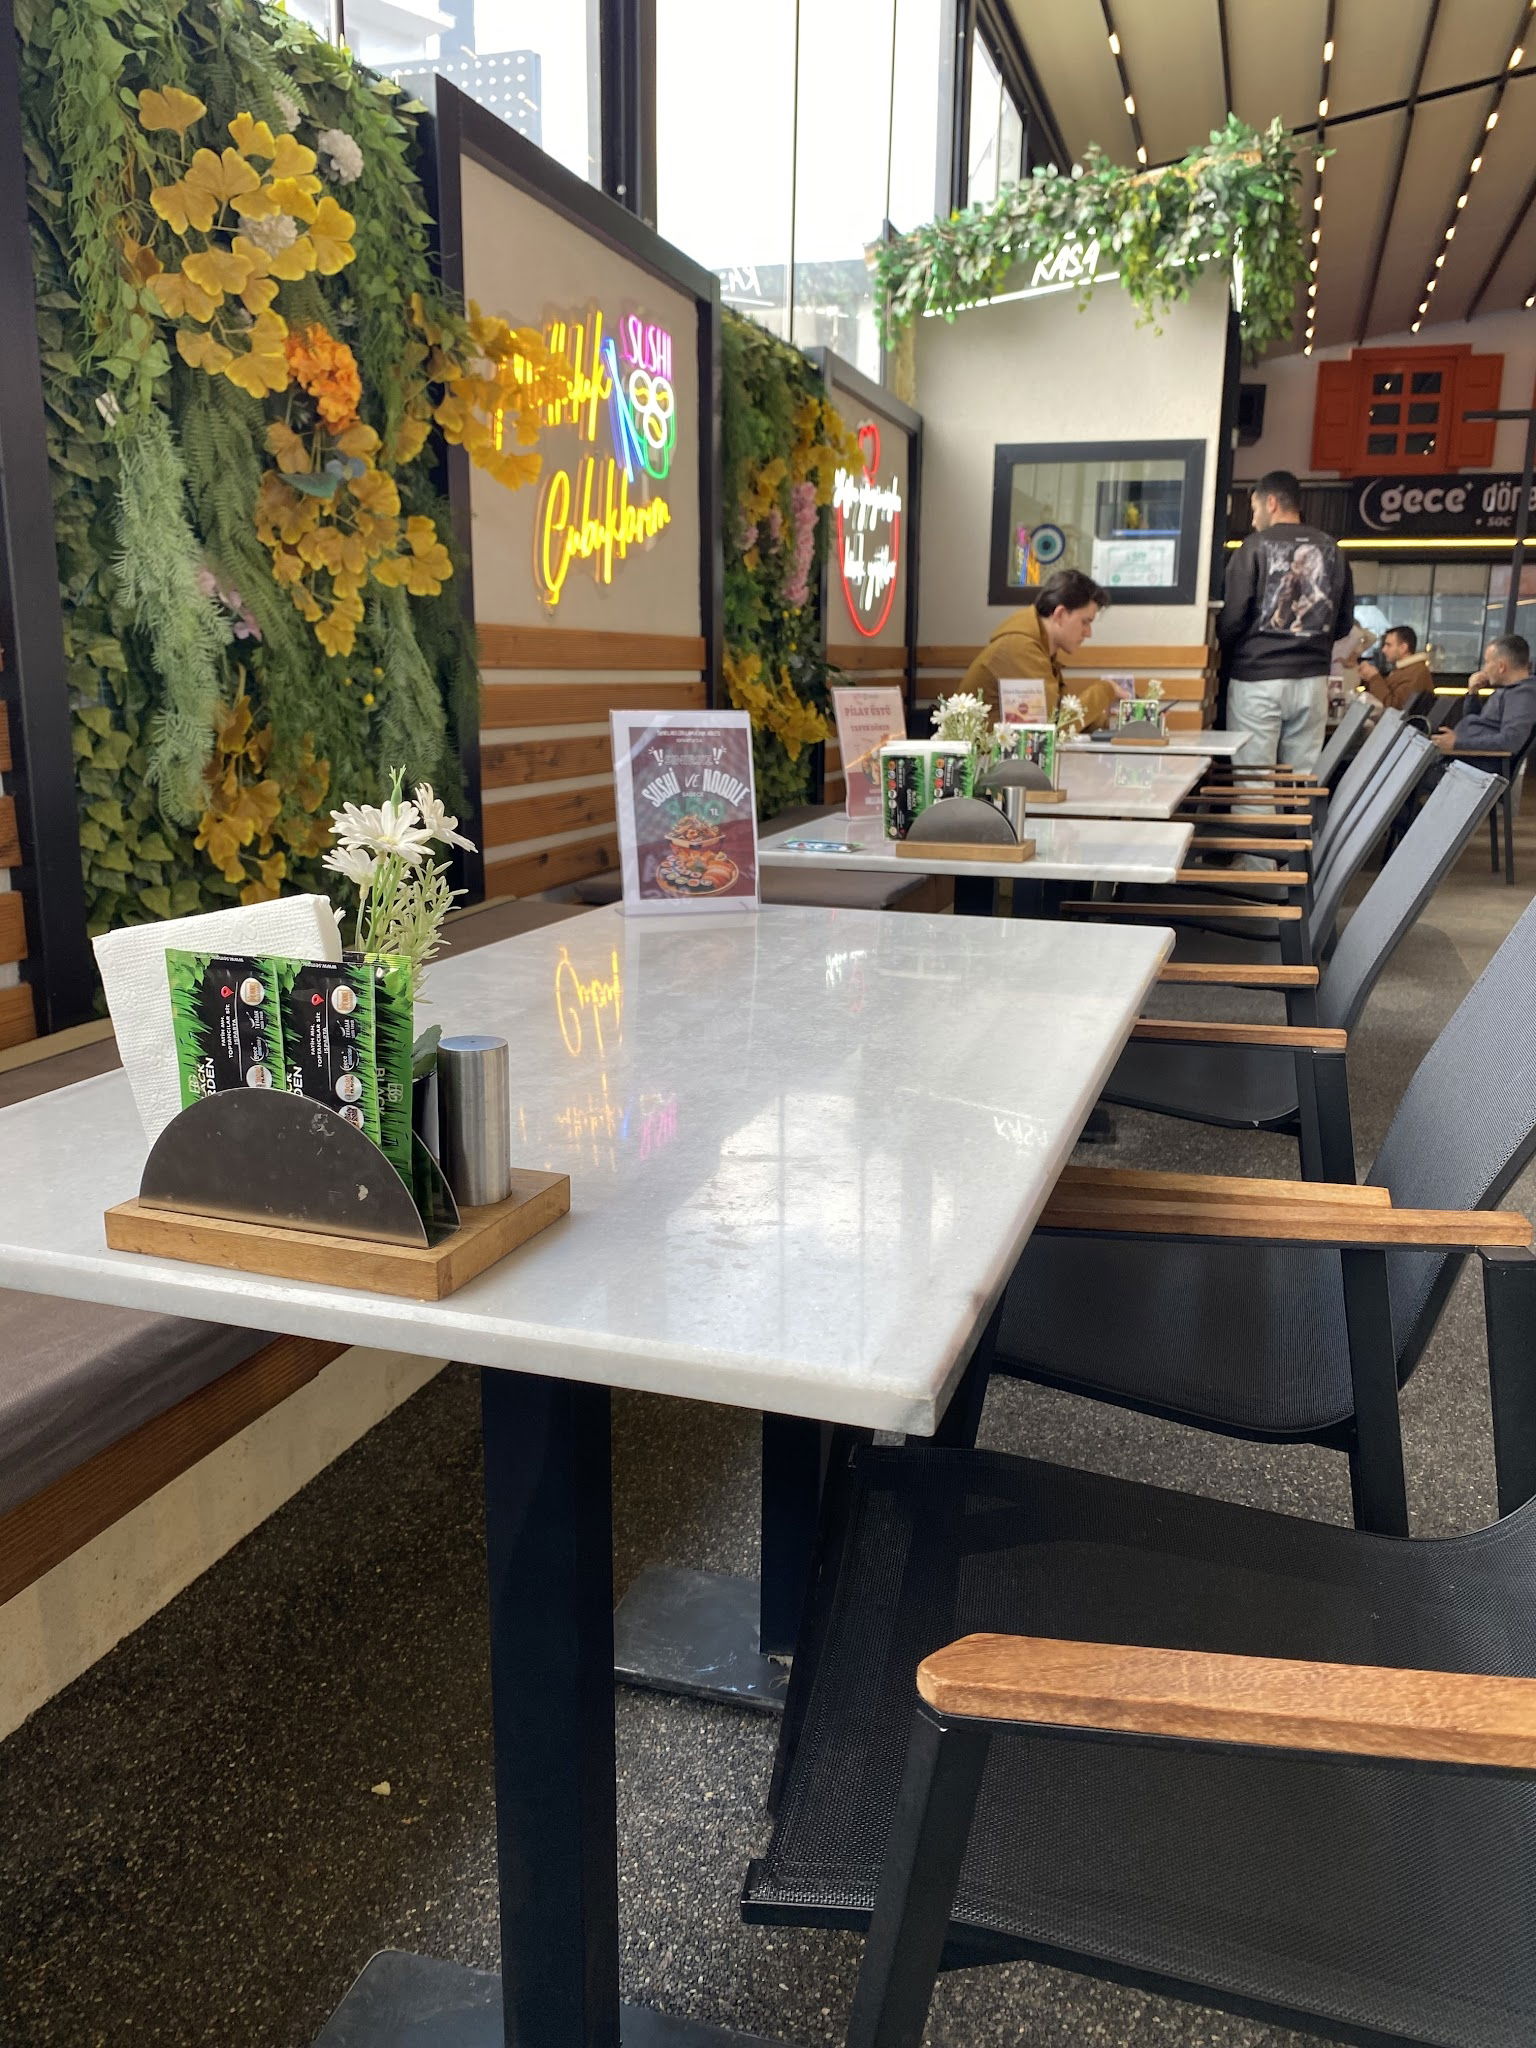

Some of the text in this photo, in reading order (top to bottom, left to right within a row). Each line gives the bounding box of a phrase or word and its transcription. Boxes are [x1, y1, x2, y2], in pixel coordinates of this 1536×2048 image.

[1031, 238, 1101, 286] KASA
[627, 313, 672, 381] SUSHI
[1380, 483, 1467, 523] gece
[684, 775, 700, 788] VE
[702, 768, 750, 807] NOODLE
[225, 1015, 233, 1058] TOPTANCILAR
